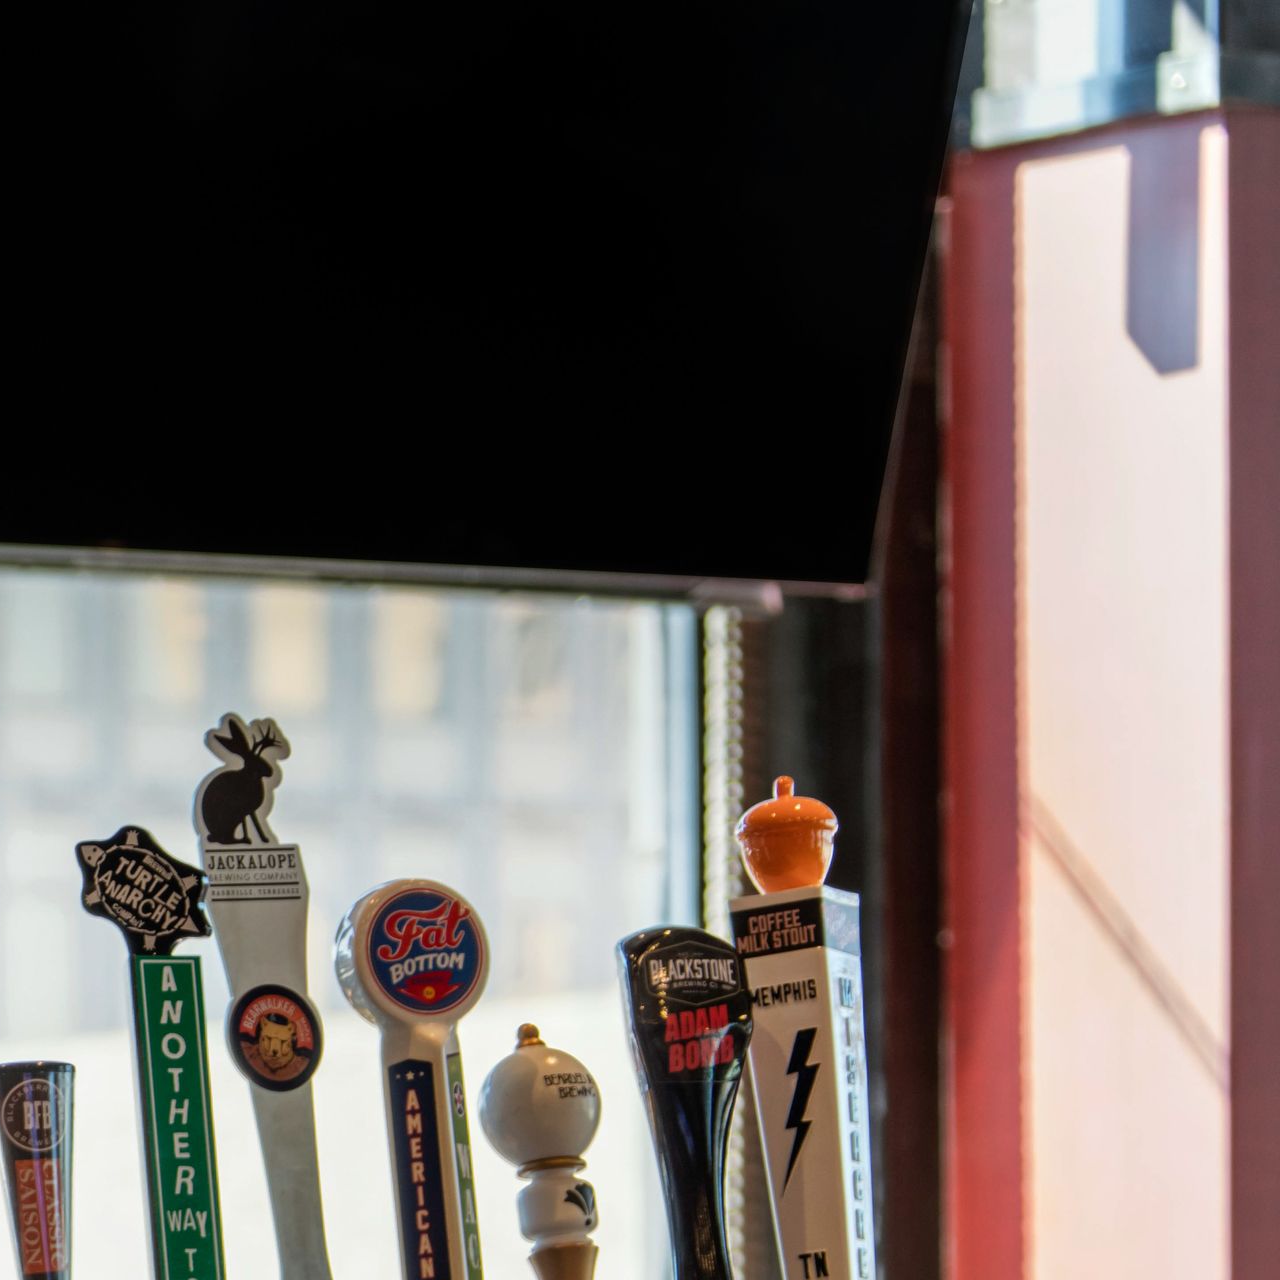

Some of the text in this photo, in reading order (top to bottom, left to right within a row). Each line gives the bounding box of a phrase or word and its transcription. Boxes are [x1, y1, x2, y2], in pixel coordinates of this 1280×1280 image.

[208, 854, 297, 870] JACKALOPE
[209, 872, 298, 882] BREWING COMPANY
[115, 856, 182, 911] TURTLE
[377, 900, 471, 961] Fat
[748, 909, 801, 934] COFFEE
[737, 932, 769, 955] MILK
[772, 924, 817, 949] STOUT
[390, 952, 465, 985] BOTTOM
[649, 958, 737, 986] BLACKSTONE
[751, 978, 817, 1007] MEMPHIS
[664, 1003, 729, 1042] ADAM
[669, 1034, 735, 1074] BOMB
[160, 965, 196, 1196] ANOTHER
[405, 1088, 436, 1279] AMERICAN
[19, 1167, 42, 1266] SAISON
[43, 1158, 65, 1268] CLASSIC
[167, 1209, 207, 1237] WAY
[798, 1251, 830, 1280] TN
